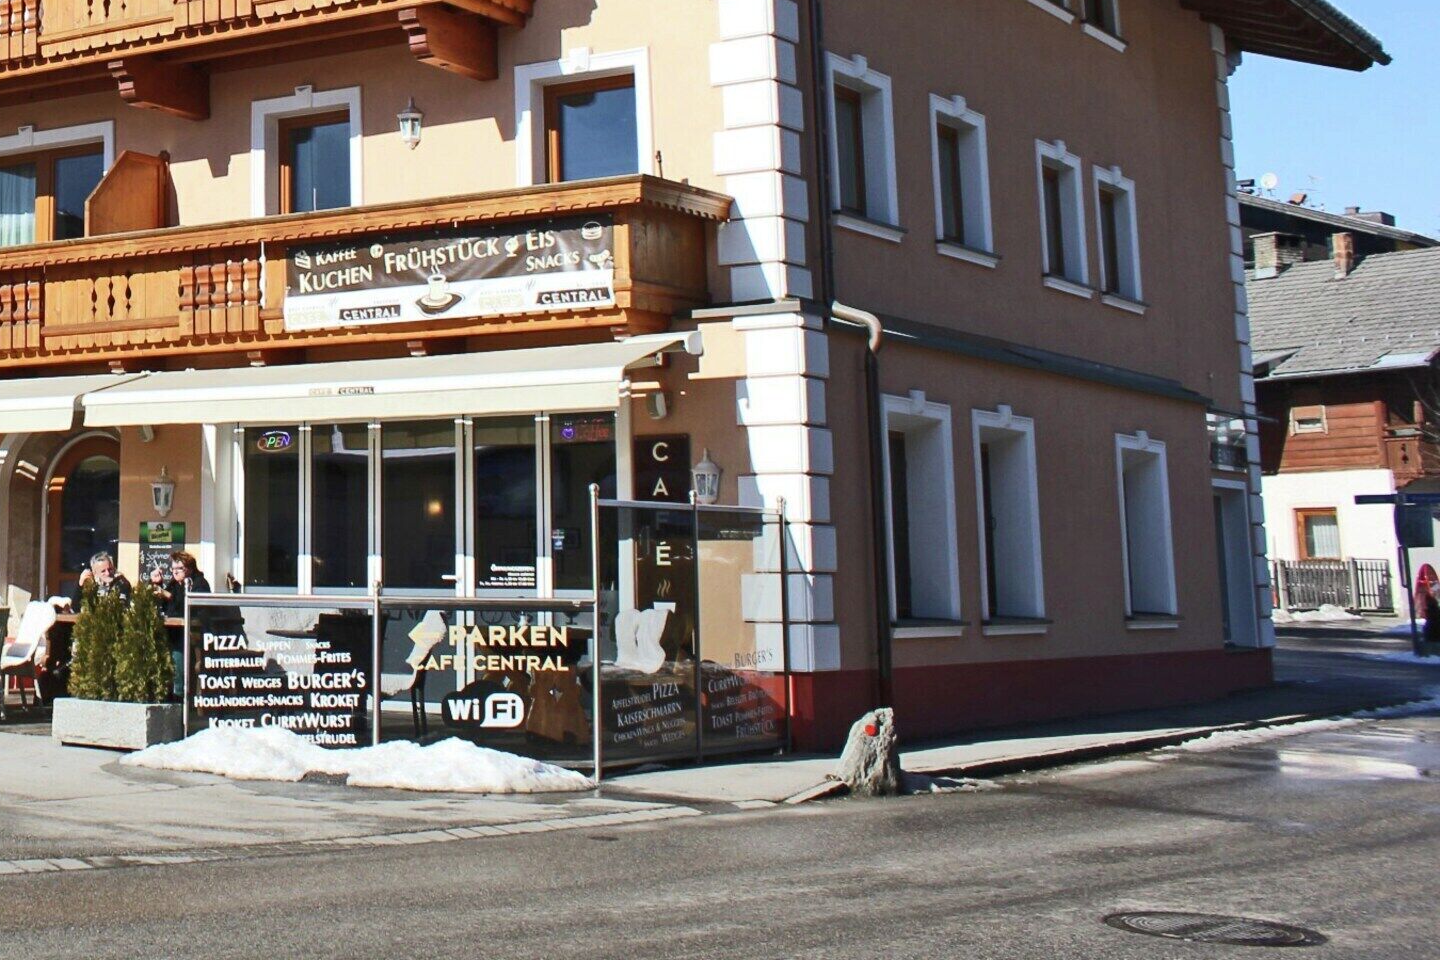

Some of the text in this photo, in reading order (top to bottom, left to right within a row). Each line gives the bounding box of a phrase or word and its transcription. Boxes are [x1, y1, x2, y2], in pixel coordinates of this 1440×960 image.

[383, 237, 500, 274] FRÜHSTÜCK
[525, 251, 581, 272] SNACKS
[299, 264, 373, 294] KUCHEN
[541, 290, 608, 304] CENTRAL
[342, 306, 399, 321] CENTRAL
[203, 633, 248, 651] PIZZA
[448, 625, 569, 647] PARKEN
[204, 651, 352, 669] BITTERBALLEN POMMES-FRITES
[473, 654, 570, 672] CENTRAL
[197, 674, 237, 690] TOAST
[241, 676, 283, 689] WEDGES
[652, 681, 680, 701] PIZZA
[193, 692, 361, 709] HOLLÄNDISCHE-SNACKS KROKET
[208, 711, 353, 730] KROKET CURRYWURST
[711, 713, 734, 729] TOAST
